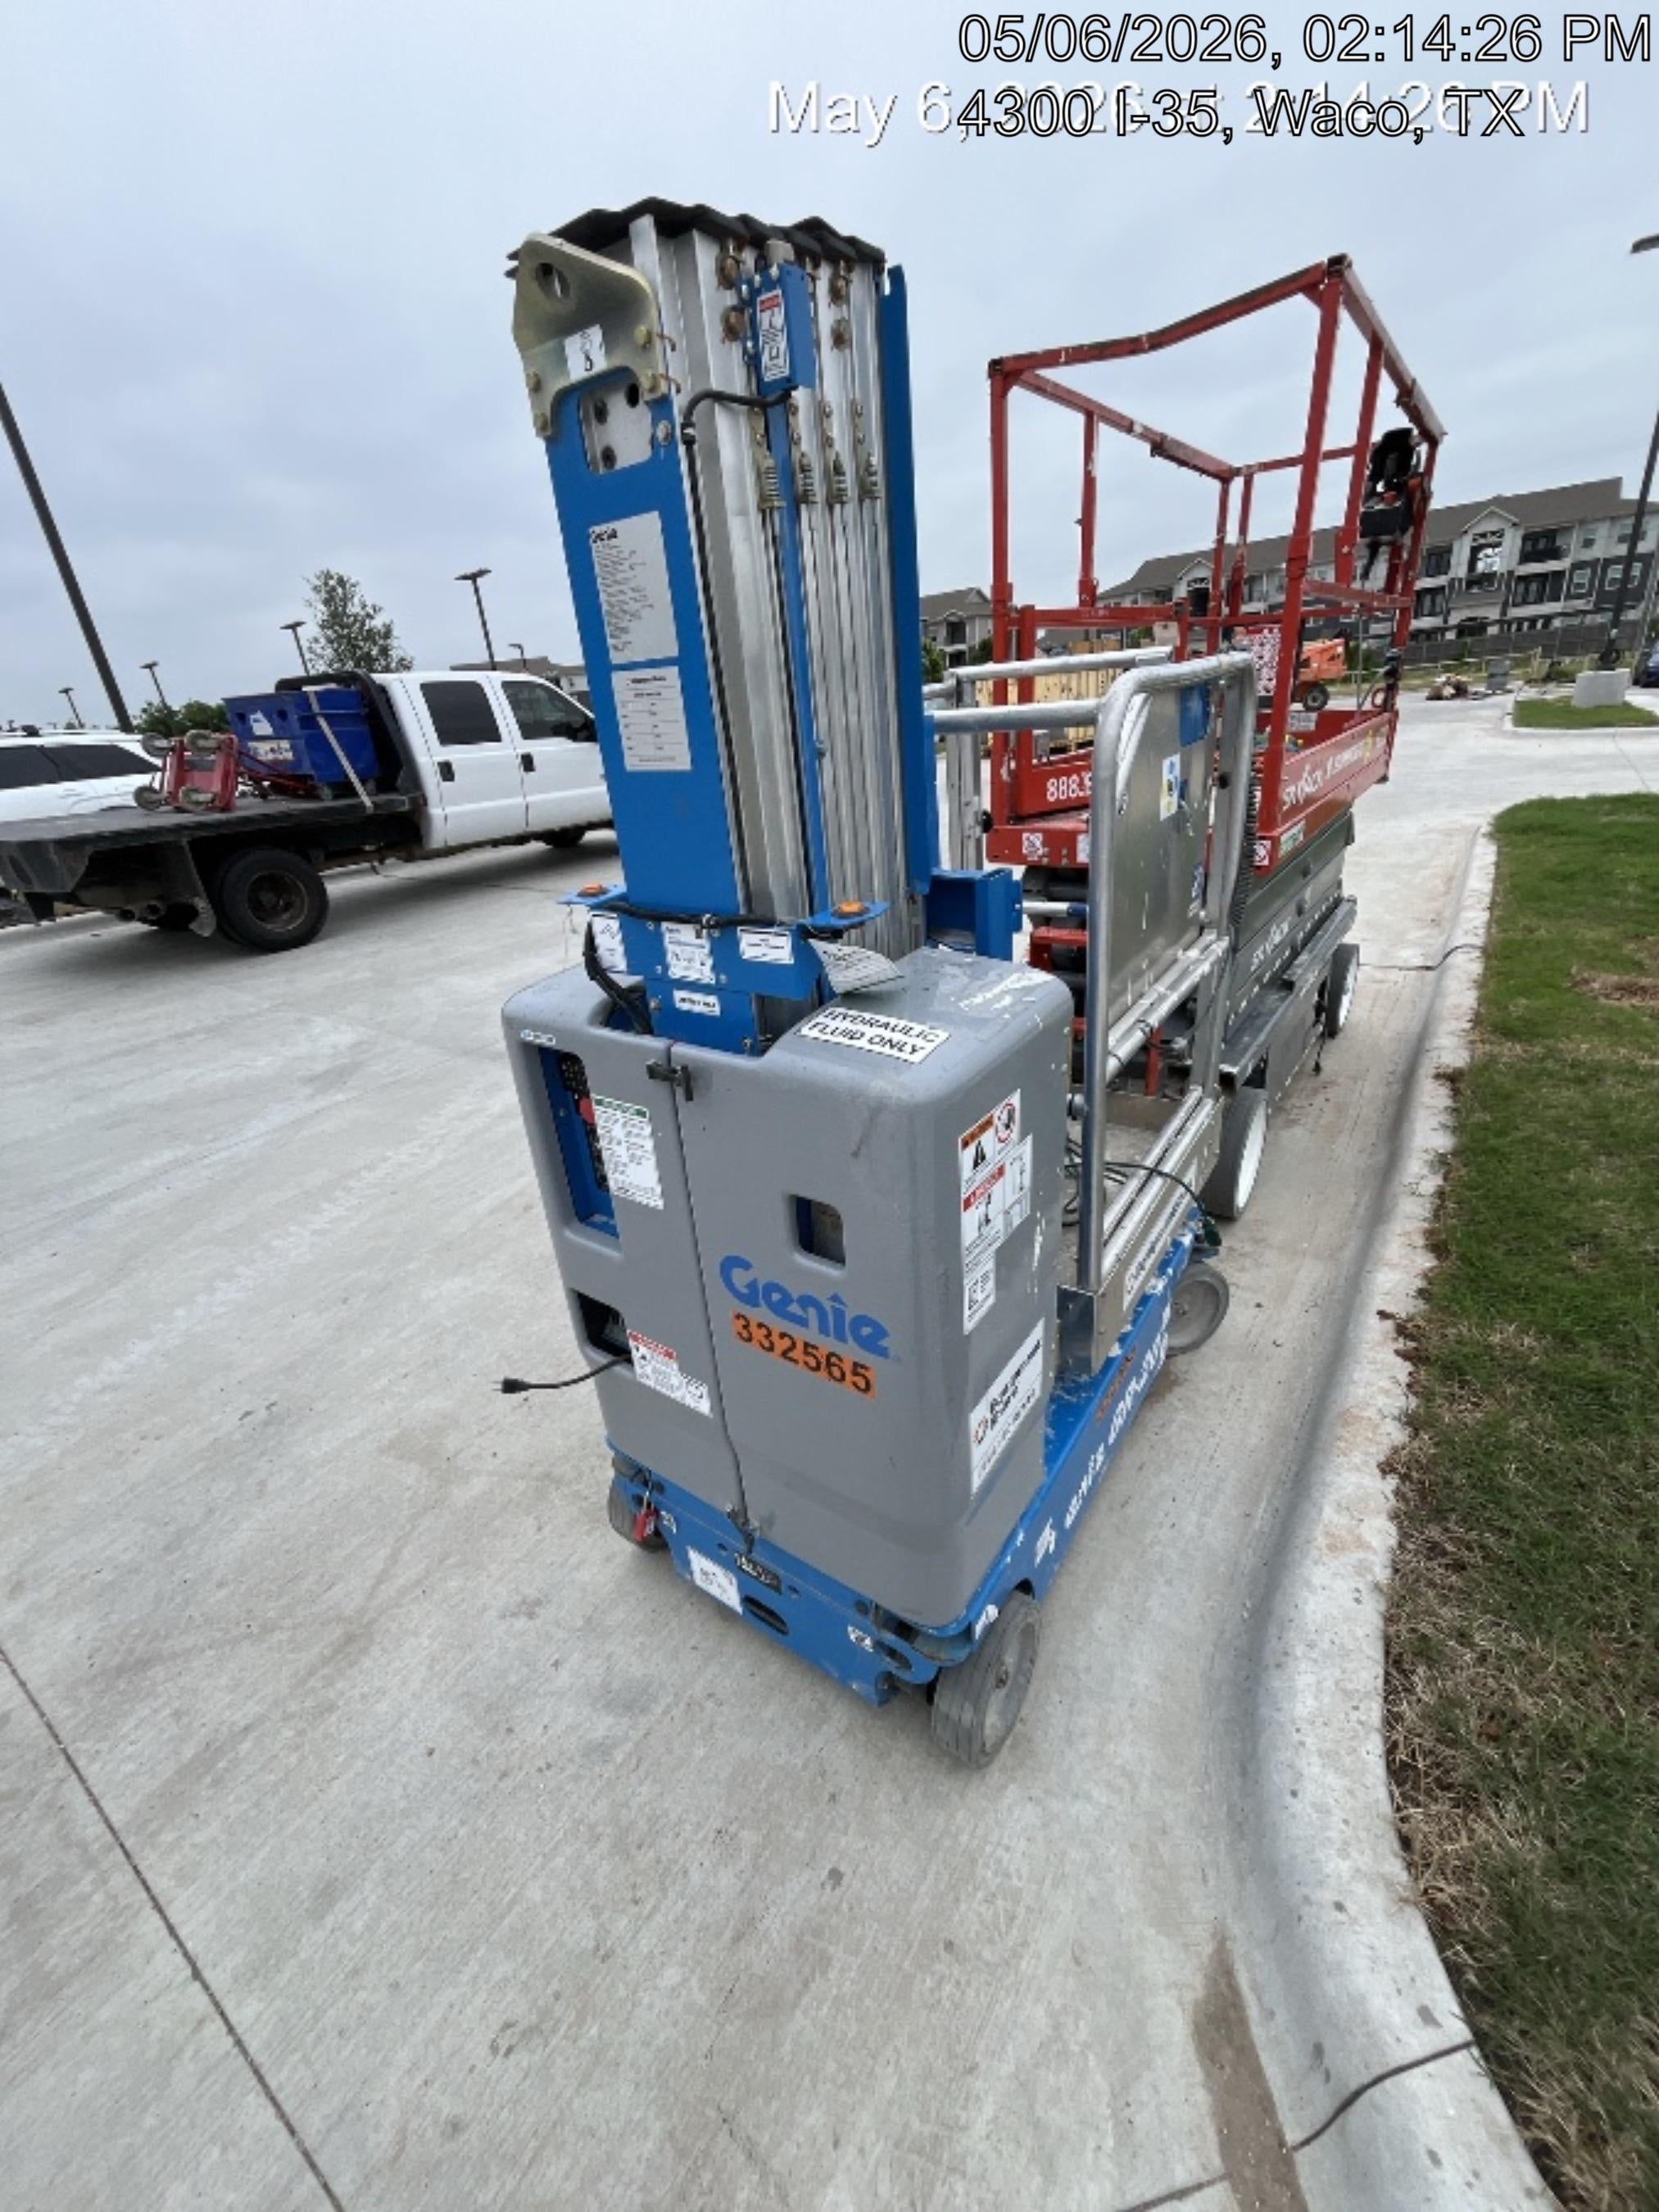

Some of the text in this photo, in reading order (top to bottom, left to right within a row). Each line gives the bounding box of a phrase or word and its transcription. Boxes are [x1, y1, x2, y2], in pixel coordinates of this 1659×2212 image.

[808, 1021, 925, 1056] FLUID ONLY
[823, 1009, 940, 1043] HYDRAULIC
[719, 1254, 892, 1360] Genie
[734, 1312, 873, 1394] 332565
